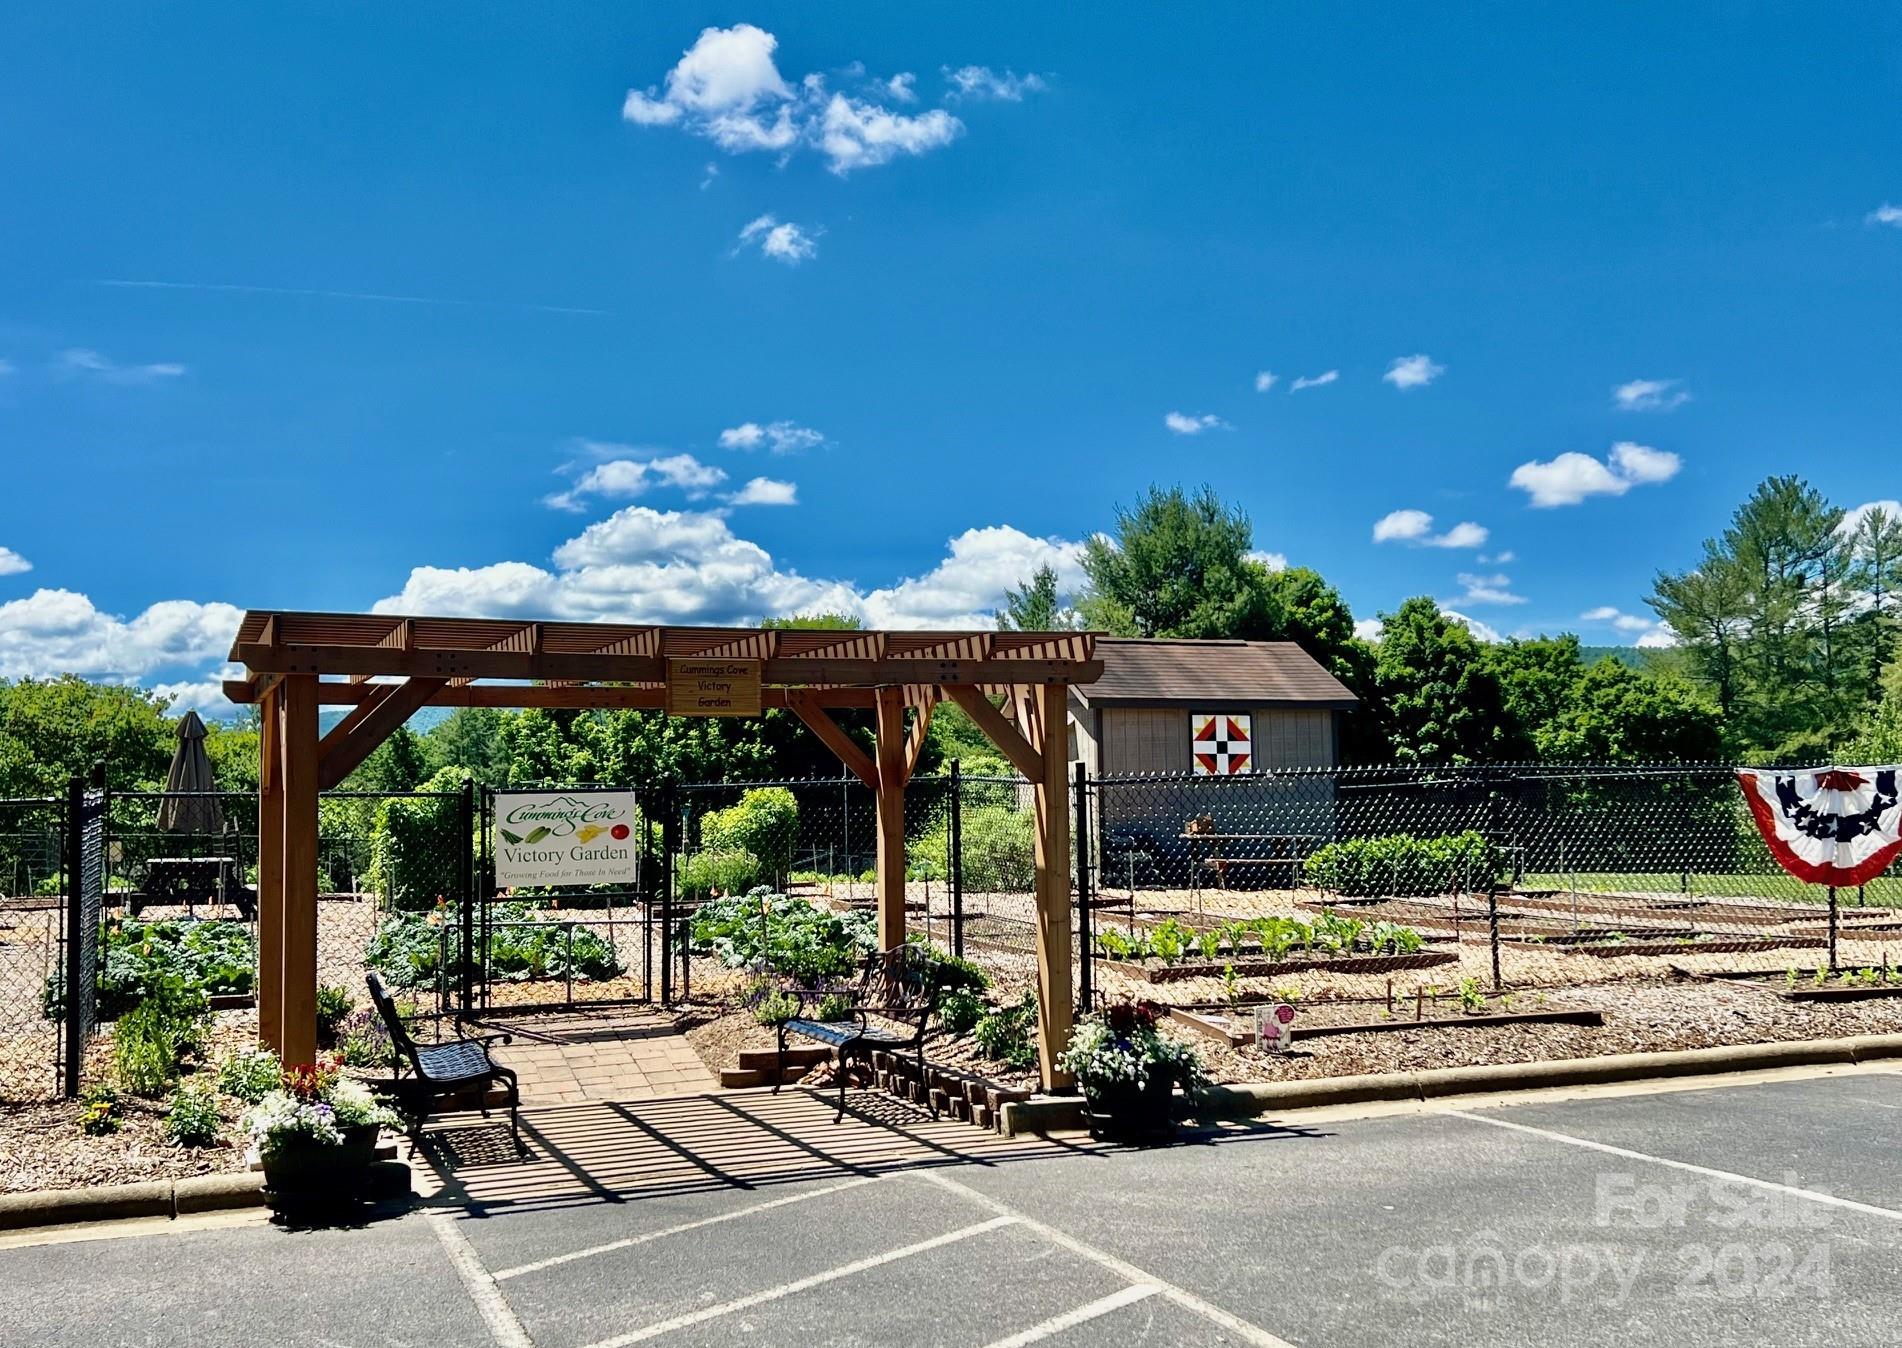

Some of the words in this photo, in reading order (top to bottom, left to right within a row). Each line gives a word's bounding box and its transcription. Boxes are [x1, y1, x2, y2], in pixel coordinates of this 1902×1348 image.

[680, 664, 725, 677] Cummings
[727, 664, 748, 674] Cove
[697, 681, 731, 694] Victory
[698, 697, 731, 707] Garden
[580, 803, 626, 822] Cove
[504, 848, 565, 865] Victory
[570, 845, 628, 862] Garden
[540, 870, 559, 878] Food
[560, 870, 572, 879] for
[574, 868, 596, 877] Those
[598, 868, 606, 876] In
